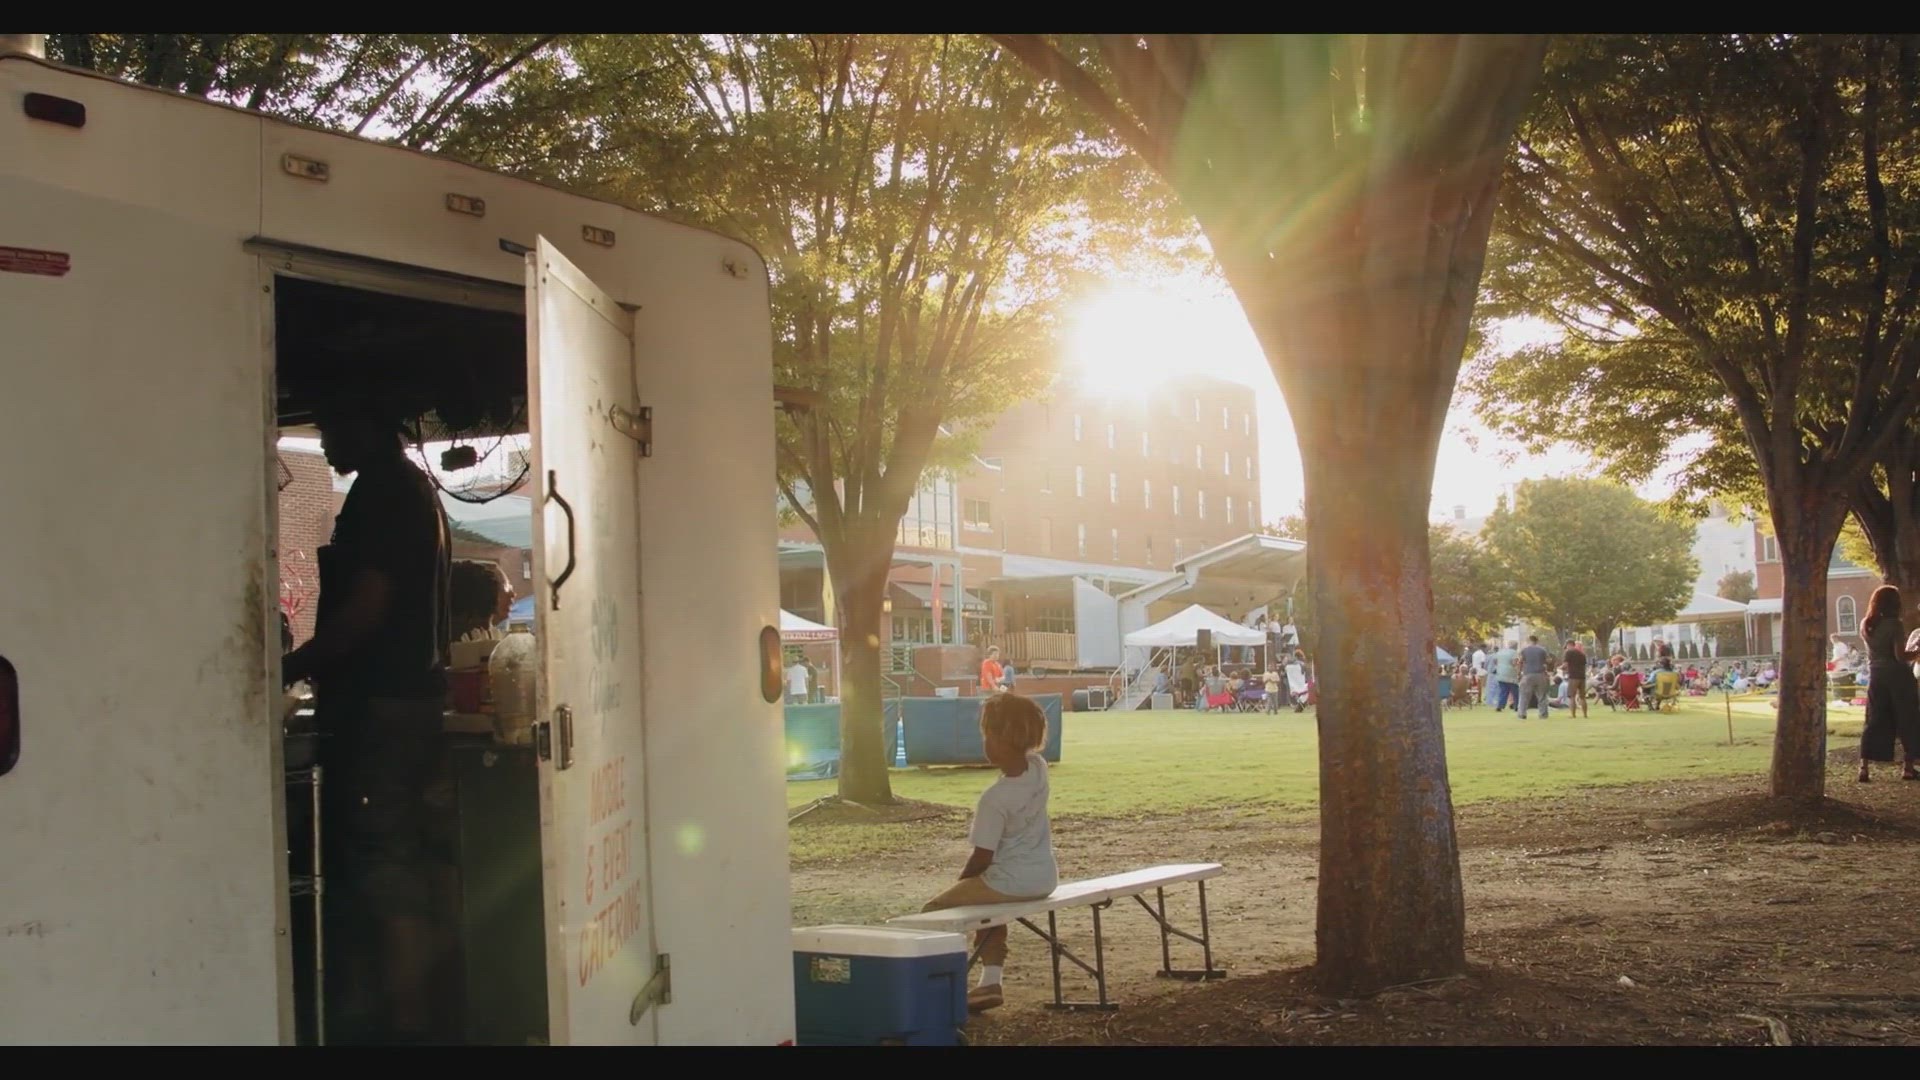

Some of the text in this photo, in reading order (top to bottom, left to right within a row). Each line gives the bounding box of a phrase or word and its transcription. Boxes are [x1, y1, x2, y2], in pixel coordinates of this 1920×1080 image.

[585, 819, 632, 905] & EVENT
[579, 878, 641, 987] CATERING
